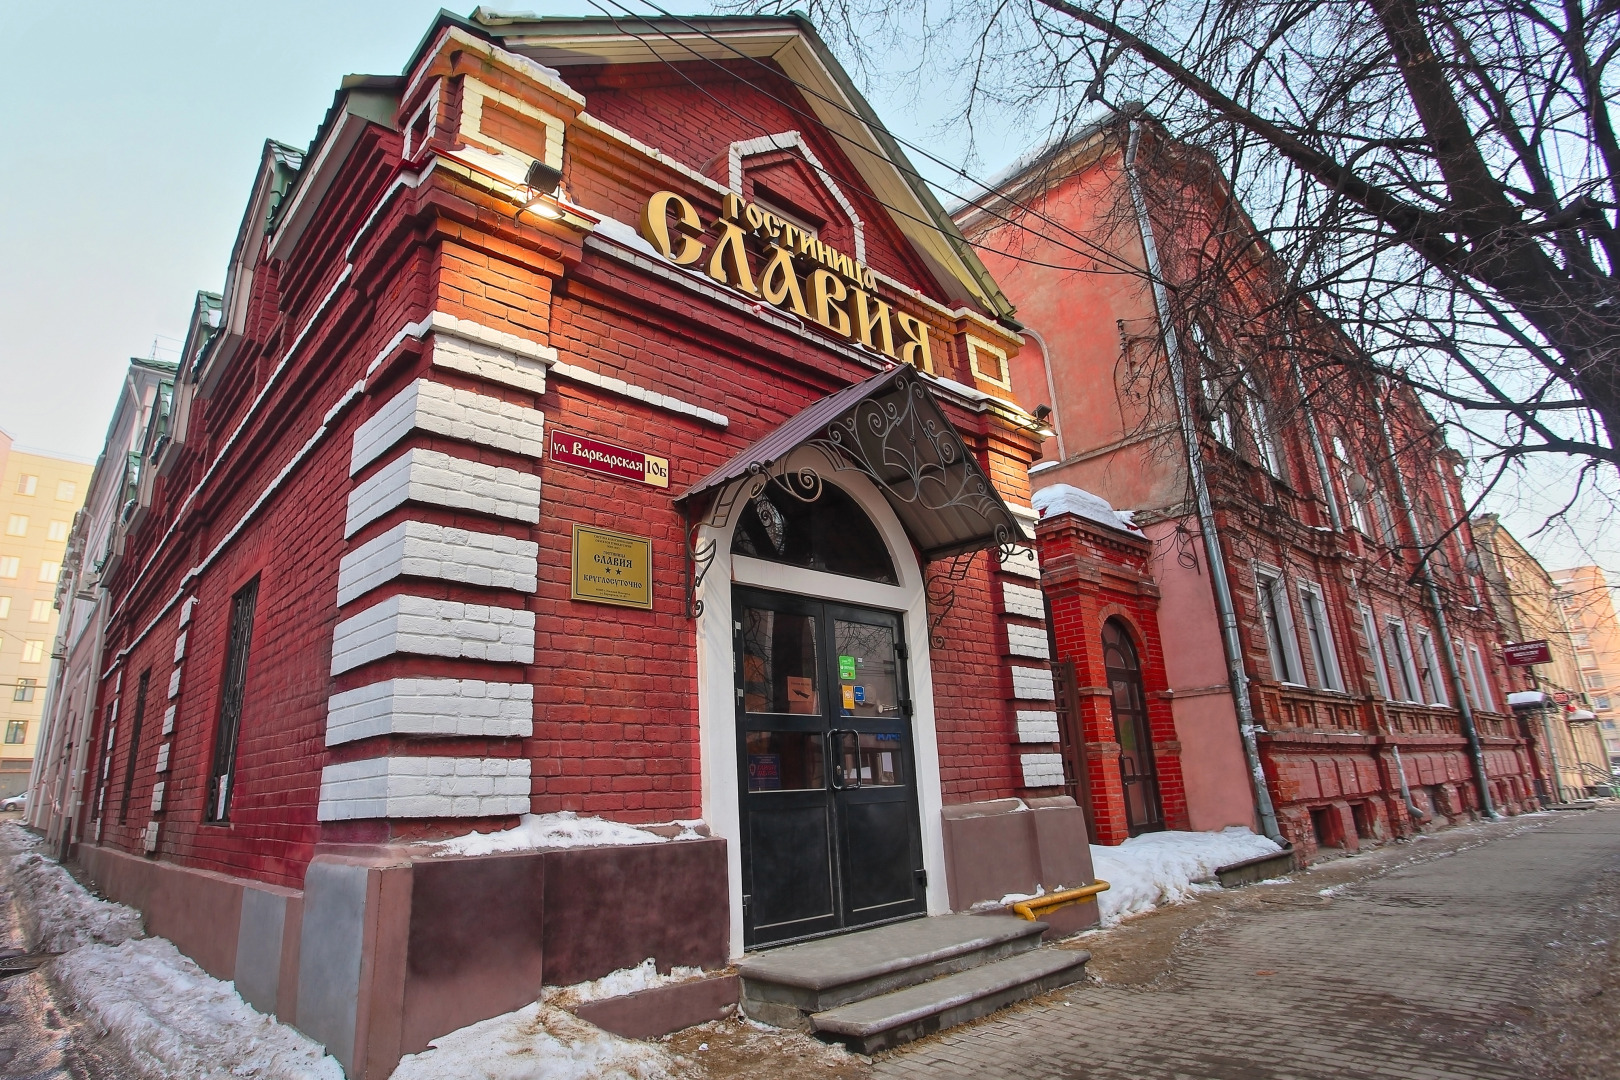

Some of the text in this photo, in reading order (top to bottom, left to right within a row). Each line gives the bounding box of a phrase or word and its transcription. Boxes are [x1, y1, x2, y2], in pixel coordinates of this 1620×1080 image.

[641, 190, 937, 379] СЛАВИЯ
[553, 442, 569, 455] ул.
[571, 442, 643, 472] Варварская
[593, 554, 632, 569] СЛАВИЯ
[583, 573, 643, 589] КРУГЛОСУТОЧНО
